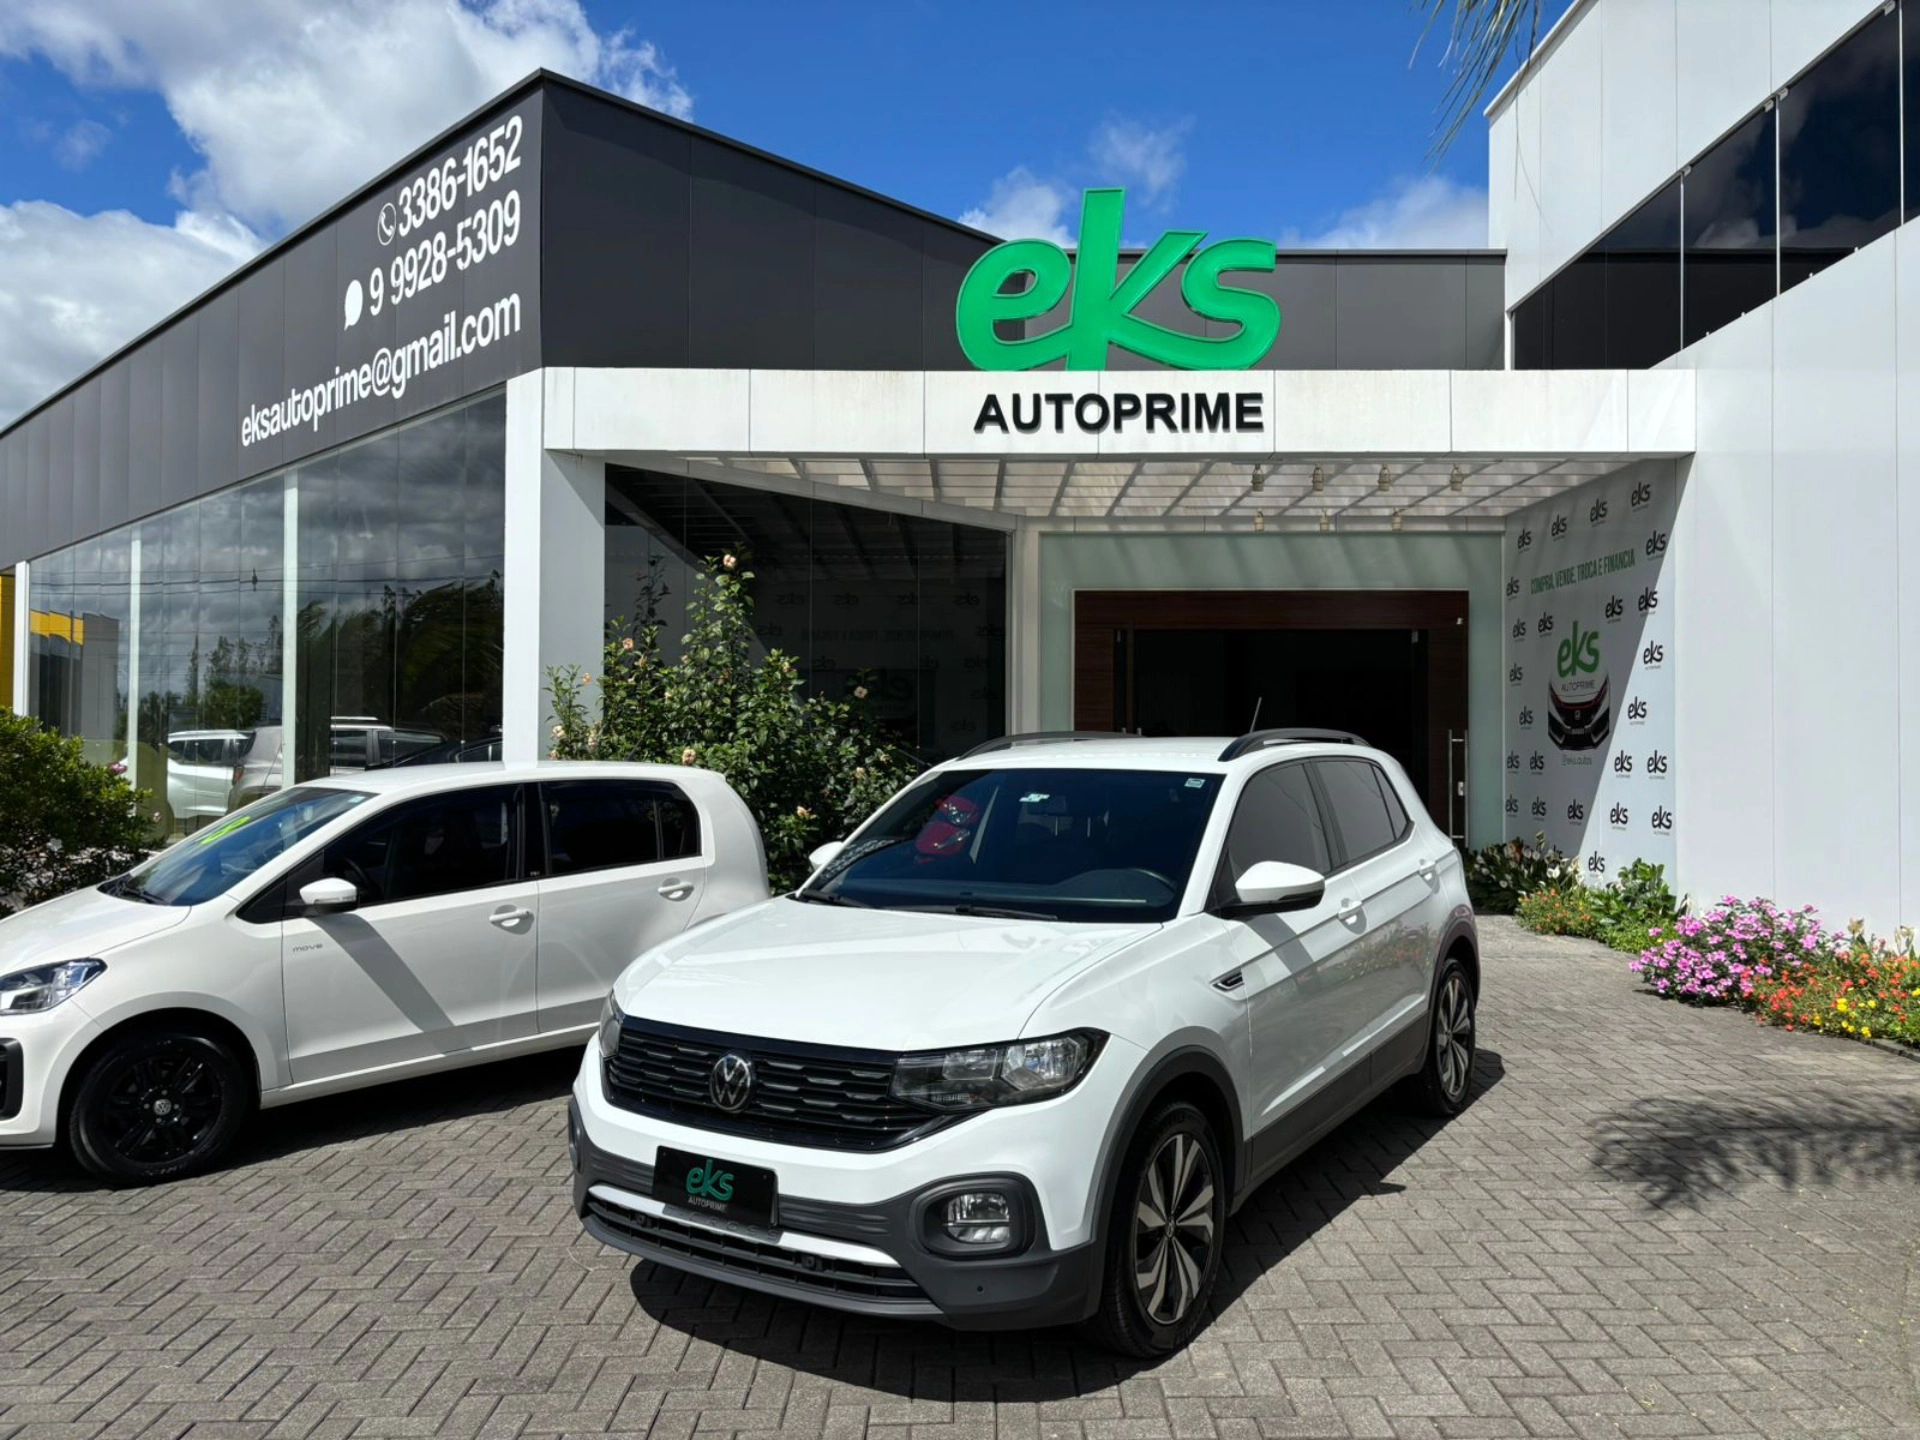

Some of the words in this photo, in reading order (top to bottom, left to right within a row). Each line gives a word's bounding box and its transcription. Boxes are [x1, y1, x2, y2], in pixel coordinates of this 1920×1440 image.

[398, 115, 523, 237] 3386-1652
[369, 267, 384, 316] 9
[390, 190, 521, 305] 9928-5309
[955, 187, 1282, 372] eks
[241, 293, 521, 447] eksautoprime@gmail.com
[974, 392, 1265, 434] AUTOPRIME
[1631, 482, 1650, 506] eks
[1590, 499, 1608, 522] eks
[1552, 515, 1568, 537] eks
[1518, 529, 1532, 549] eks
[1646, 530, 1667, 556] eks
[1578, 560, 1597, 582] TROCA
[1598, 558, 1602, 577] E
[1603, 548, 1635, 574] FINANCIA
[1506, 577, 1520, 596] eks
[1605, 595, 1623, 618] eks
[1638, 587, 1658, 611] eks
[1513, 618, 1526, 638] eks
[1538, 612, 1554, 632] eks
[1557, 620, 1599, 678] eks
[1519, 706, 1533, 725] eks
[1628, 696, 1647, 720] eks
[686, 1159, 734, 1201] eks
[688, 1194, 727, 1213] AUTOPRIME
